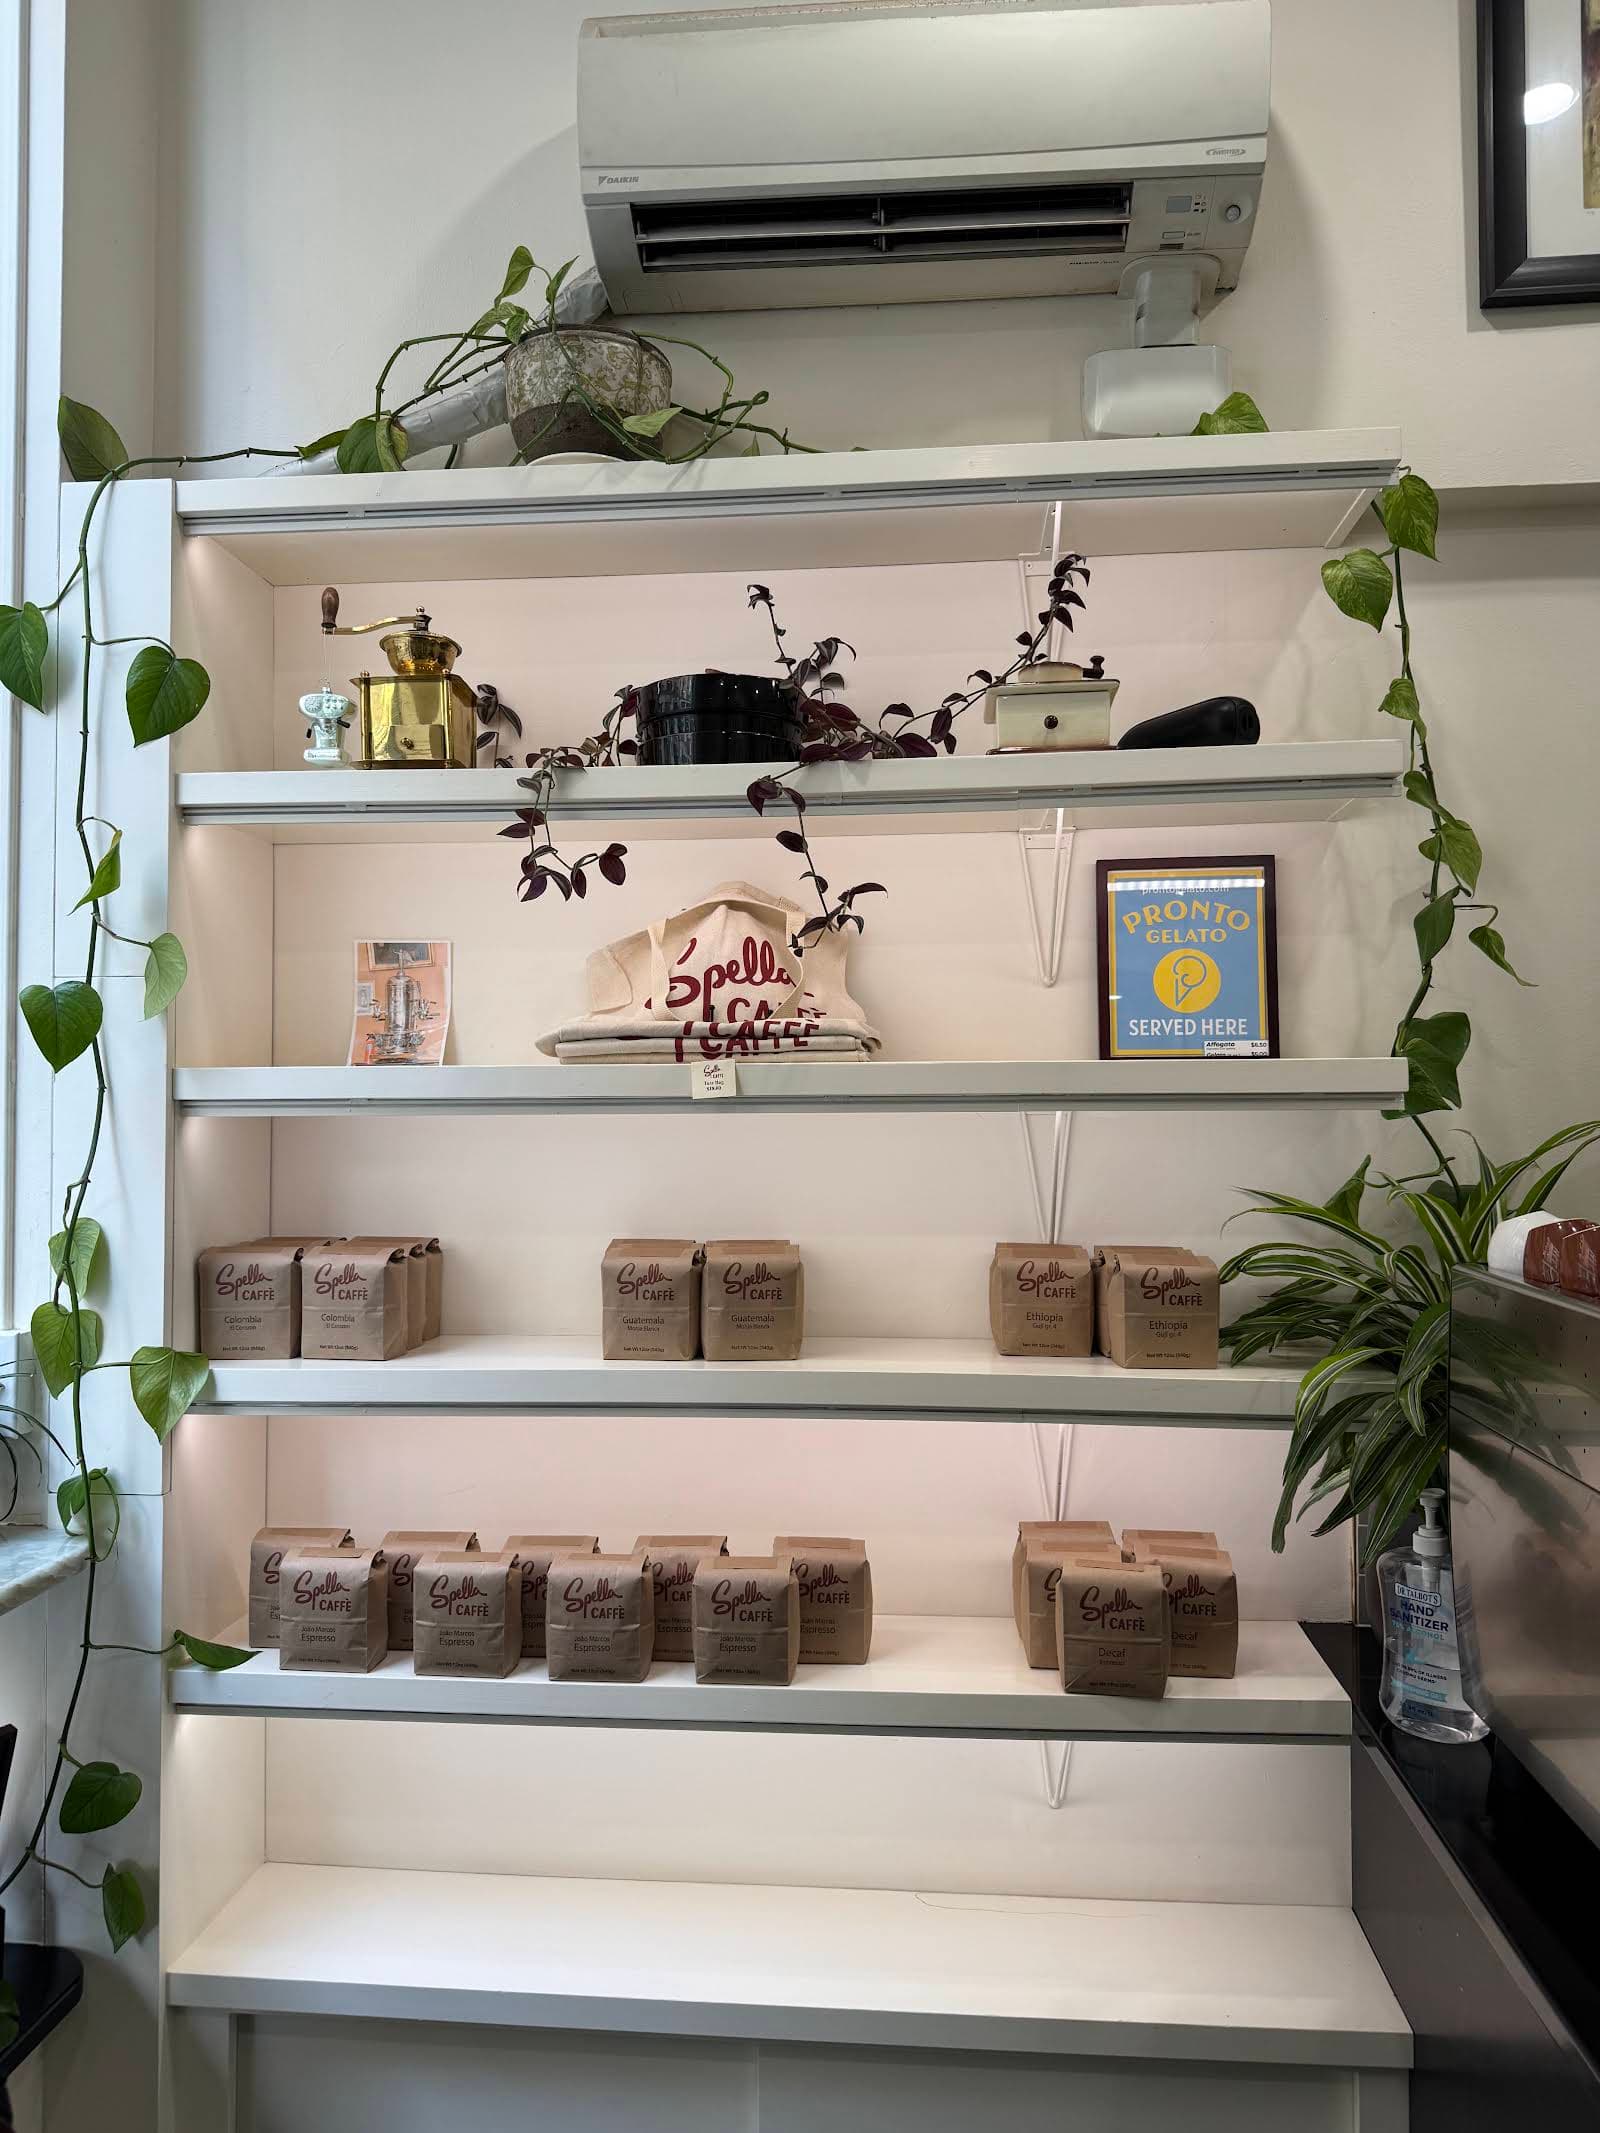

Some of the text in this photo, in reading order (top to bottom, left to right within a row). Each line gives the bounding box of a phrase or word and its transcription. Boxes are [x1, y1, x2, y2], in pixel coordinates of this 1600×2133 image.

[607, 176, 639, 184] DAIKIN
[1122, 900, 1250, 934] PRONTO
[1145, 928, 1227, 944] GELATO
[1129, 1018, 1249, 1036] SERVED HERE
[215, 1263, 273, 1301] Spella
[314, 1263, 367, 1300] Spella
[616, 1262, 672, 1301] Spella
[722, 1262, 780, 1301] Spella
[1016, 1260, 1074, 1298] Spella
[1140, 1266, 1201, 1306] Spella
[242, 1287, 275, 1301] CAFFÈ
[338, 1287, 368, 1301] CAFFÈ
[642, 1287, 675, 1301] CAFFÈ
[750, 1287, 782, 1301] CAFFÈ
[1044, 1285, 1076, 1299] CAFFÈ
[1169, 1293, 1203, 1307] CAFFÈ
[224, 1315, 262, 1324] Colombia
[321, 1313, 355, 1323] Colombia
[622, 1315, 665, 1325] Guatemala
[731, 1314, 775, 1323] Guatemala
[1026, 1311, 1064, 1324] Ethiopia
[1149, 1320, 1188, 1331] Ethiopia
[522, 1561, 552, 1600] Spe
[796, 1563, 848, 1604] Spella
[293, 1569, 350, 1610] Spella
[429, 1574, 488, 1616] Spella
[671, 1590, 692, 1602] CAF
[817, 1590, 850, 1604] CAFFÈ
[319, 1597, 352, 1612] CAFFÈ
[563, 1577, 623, 1618] Spella
[711, 1579, 771, 1622] Spella
[455, 1602, 489, 1617] CAFFÈ
[591, 1605, 625, 1620] CAFFÈ
[1079, 1585, 1143, 1629] Spella
[1182, 1602, 1217, 1617] CAFFÈ
[1400, 1599, 1434, 1617] HAND
[740, 1608, 773, 1622] CAFFÈ
[1390, 1607, 1449, 1632] SANITIZER
[1109, 1617, 1145, 1632] CAFFÈ
[301, 1633, 336, 1643] Espresso
[439, 1637, 475, 1647] Espresso
[574, 1642, 611, 1653] Espresso
[720, 1643, 757, 1654] Espresso
[1098, 1647, 1126, 1658] Decaf
